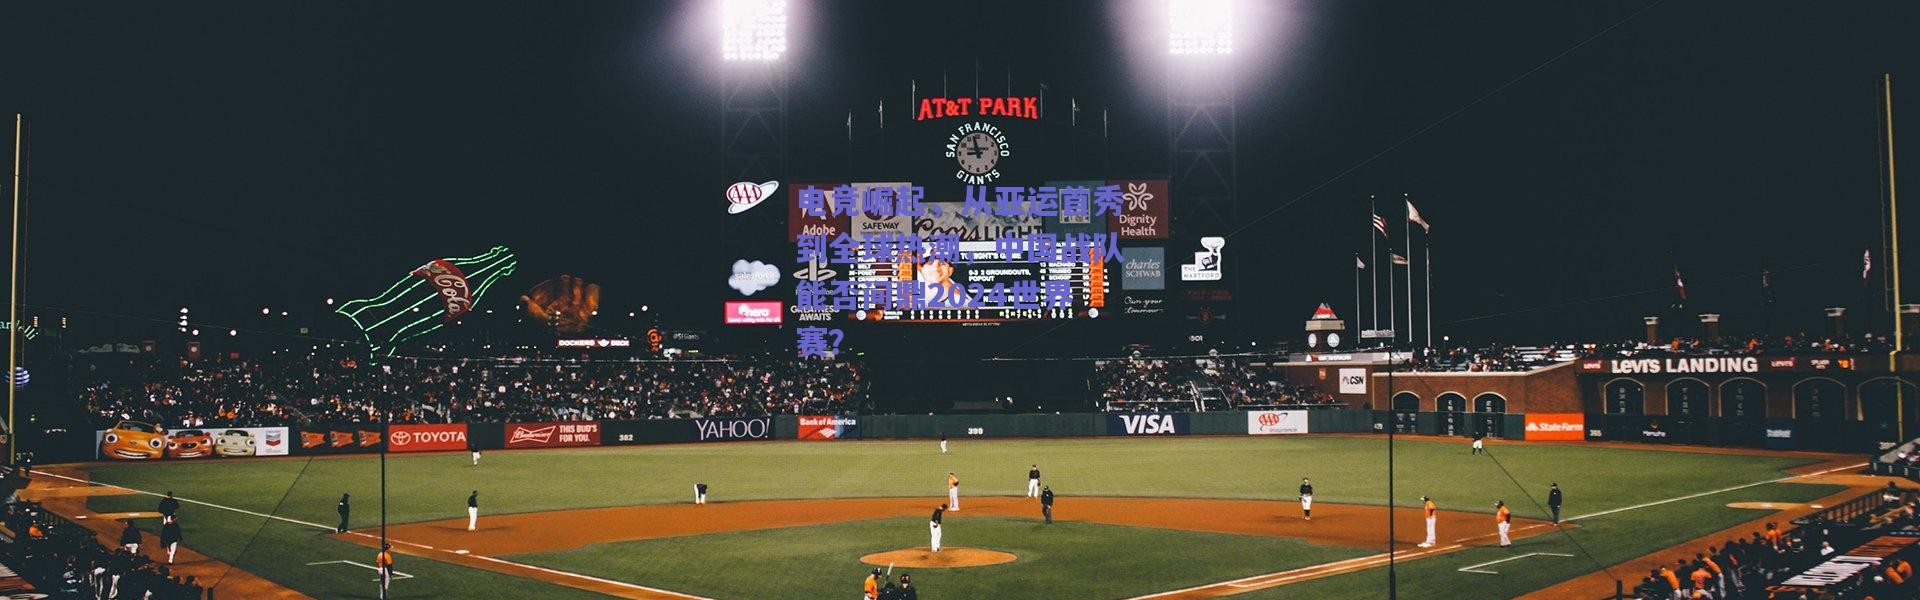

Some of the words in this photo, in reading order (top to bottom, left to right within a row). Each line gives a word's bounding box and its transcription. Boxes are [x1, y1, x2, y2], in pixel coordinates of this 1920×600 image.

[917, 98, 972, 120] AT&T
[978, 97, 1038, 119] PARK
[945, 133, 960, 158] SAN
[958, 121, 1010, 157] FRANCISCO
[956, 169, 1000, 185] GIANTS
[728, 184, 762, 204] AAA
[862, 222, 899, 230] SAFEWAY
[1119, 214, 1157, 227] Dignity
[803, 224, 836, 236] Adobe
[1121, 226, 1156, 236] Health
[1125, 259, 1160, 270] charles
[1125, 270, 1161, 278] SCHWAB
[798, 313, 832, 321] AWAITS
[1666, 357, 1759, 373] LANDING
[1349, 376, 1363, 385] CSN
[800, 418, 818, 426] Bank
[819, 418, 827, 426] of
[826, 418, 856, 426] America
[1119, 415, 1175, 434] VISA
[1258, 413, 1280, 426] AAA
[559, 425, 575, 433] THIS
[576, 424, 597, 433] BUD'S
[695, 418, 770, 440] YAHOO!
[413, 432, 466, 443] TOYOTA
[559, 434, 573, 442] FOR
[574, 434, 590, 442] YOU.
